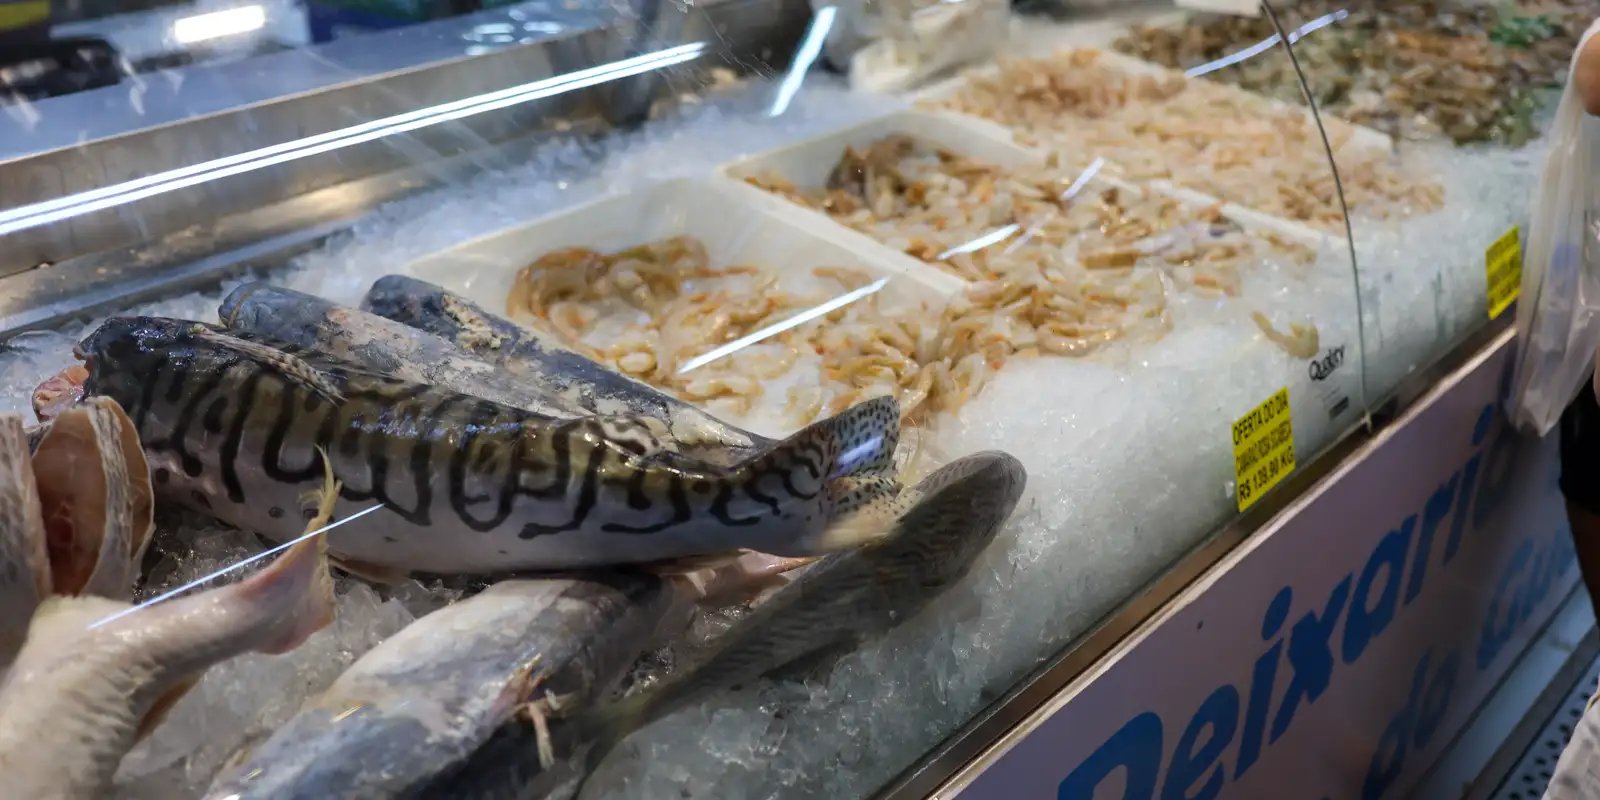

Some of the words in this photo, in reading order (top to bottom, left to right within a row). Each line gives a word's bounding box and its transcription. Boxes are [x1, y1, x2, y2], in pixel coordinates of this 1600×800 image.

[1232, 410, 1262, 446] OFERTA
[1238, 478, 1251, 503] R$
[1279, 445, 1294, 469] KG
